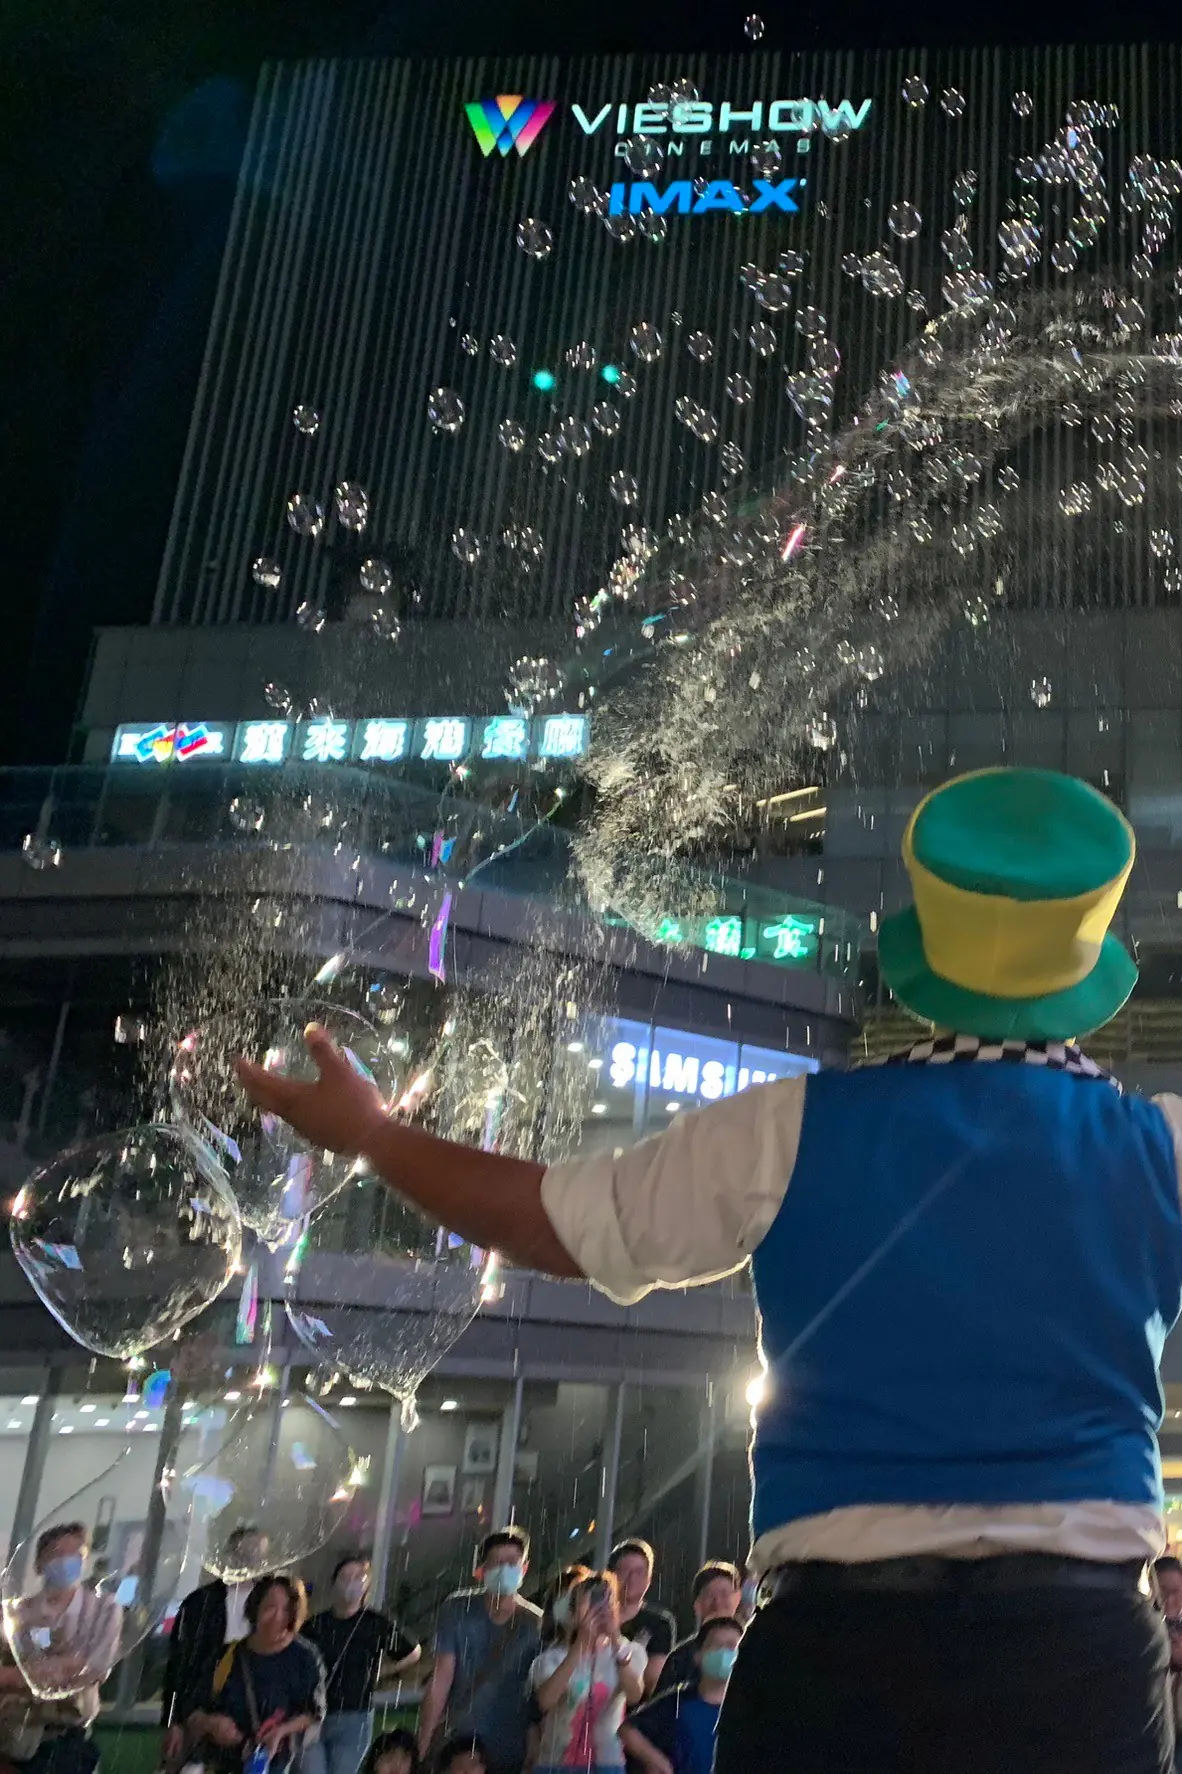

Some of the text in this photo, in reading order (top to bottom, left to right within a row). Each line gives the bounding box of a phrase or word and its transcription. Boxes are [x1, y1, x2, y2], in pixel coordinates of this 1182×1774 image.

[571, 98, 873, 135] VIESHOW
[614, 138, 812, 157] CINEMAS
[607, 178, 798, 216] IMAX
